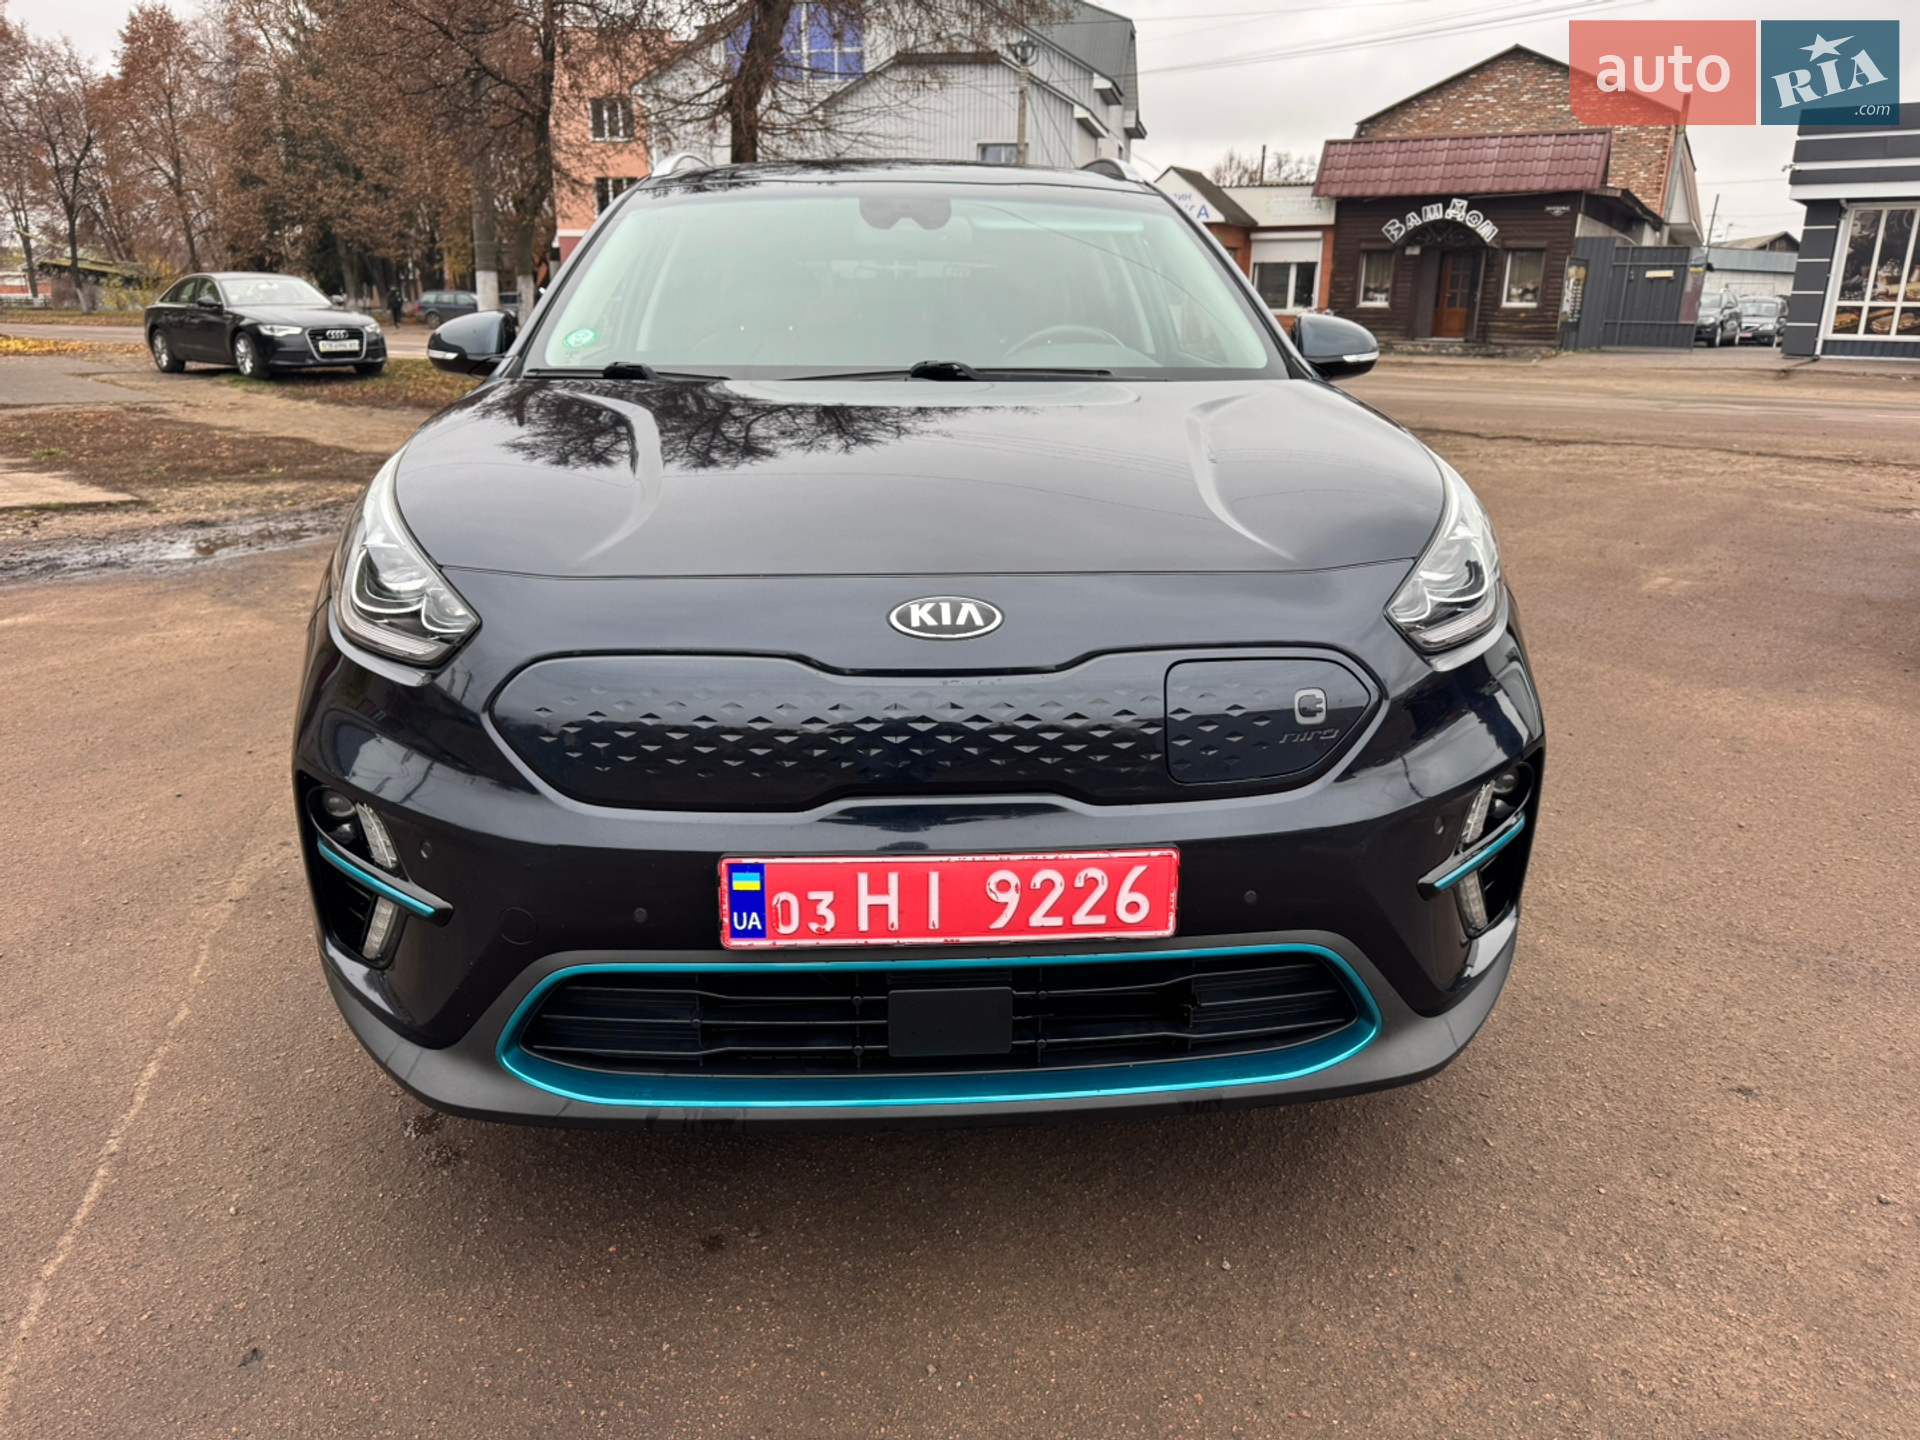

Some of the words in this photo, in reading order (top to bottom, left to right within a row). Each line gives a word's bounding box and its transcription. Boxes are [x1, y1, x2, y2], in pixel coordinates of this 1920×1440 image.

[909, 602, 985, 628] KIA
[771, 890, 836, 935] 03
[857, 871, 940, 932] HI
[985, 864, 1151, 930] 9226
[733, 911, 762, 931] UA
